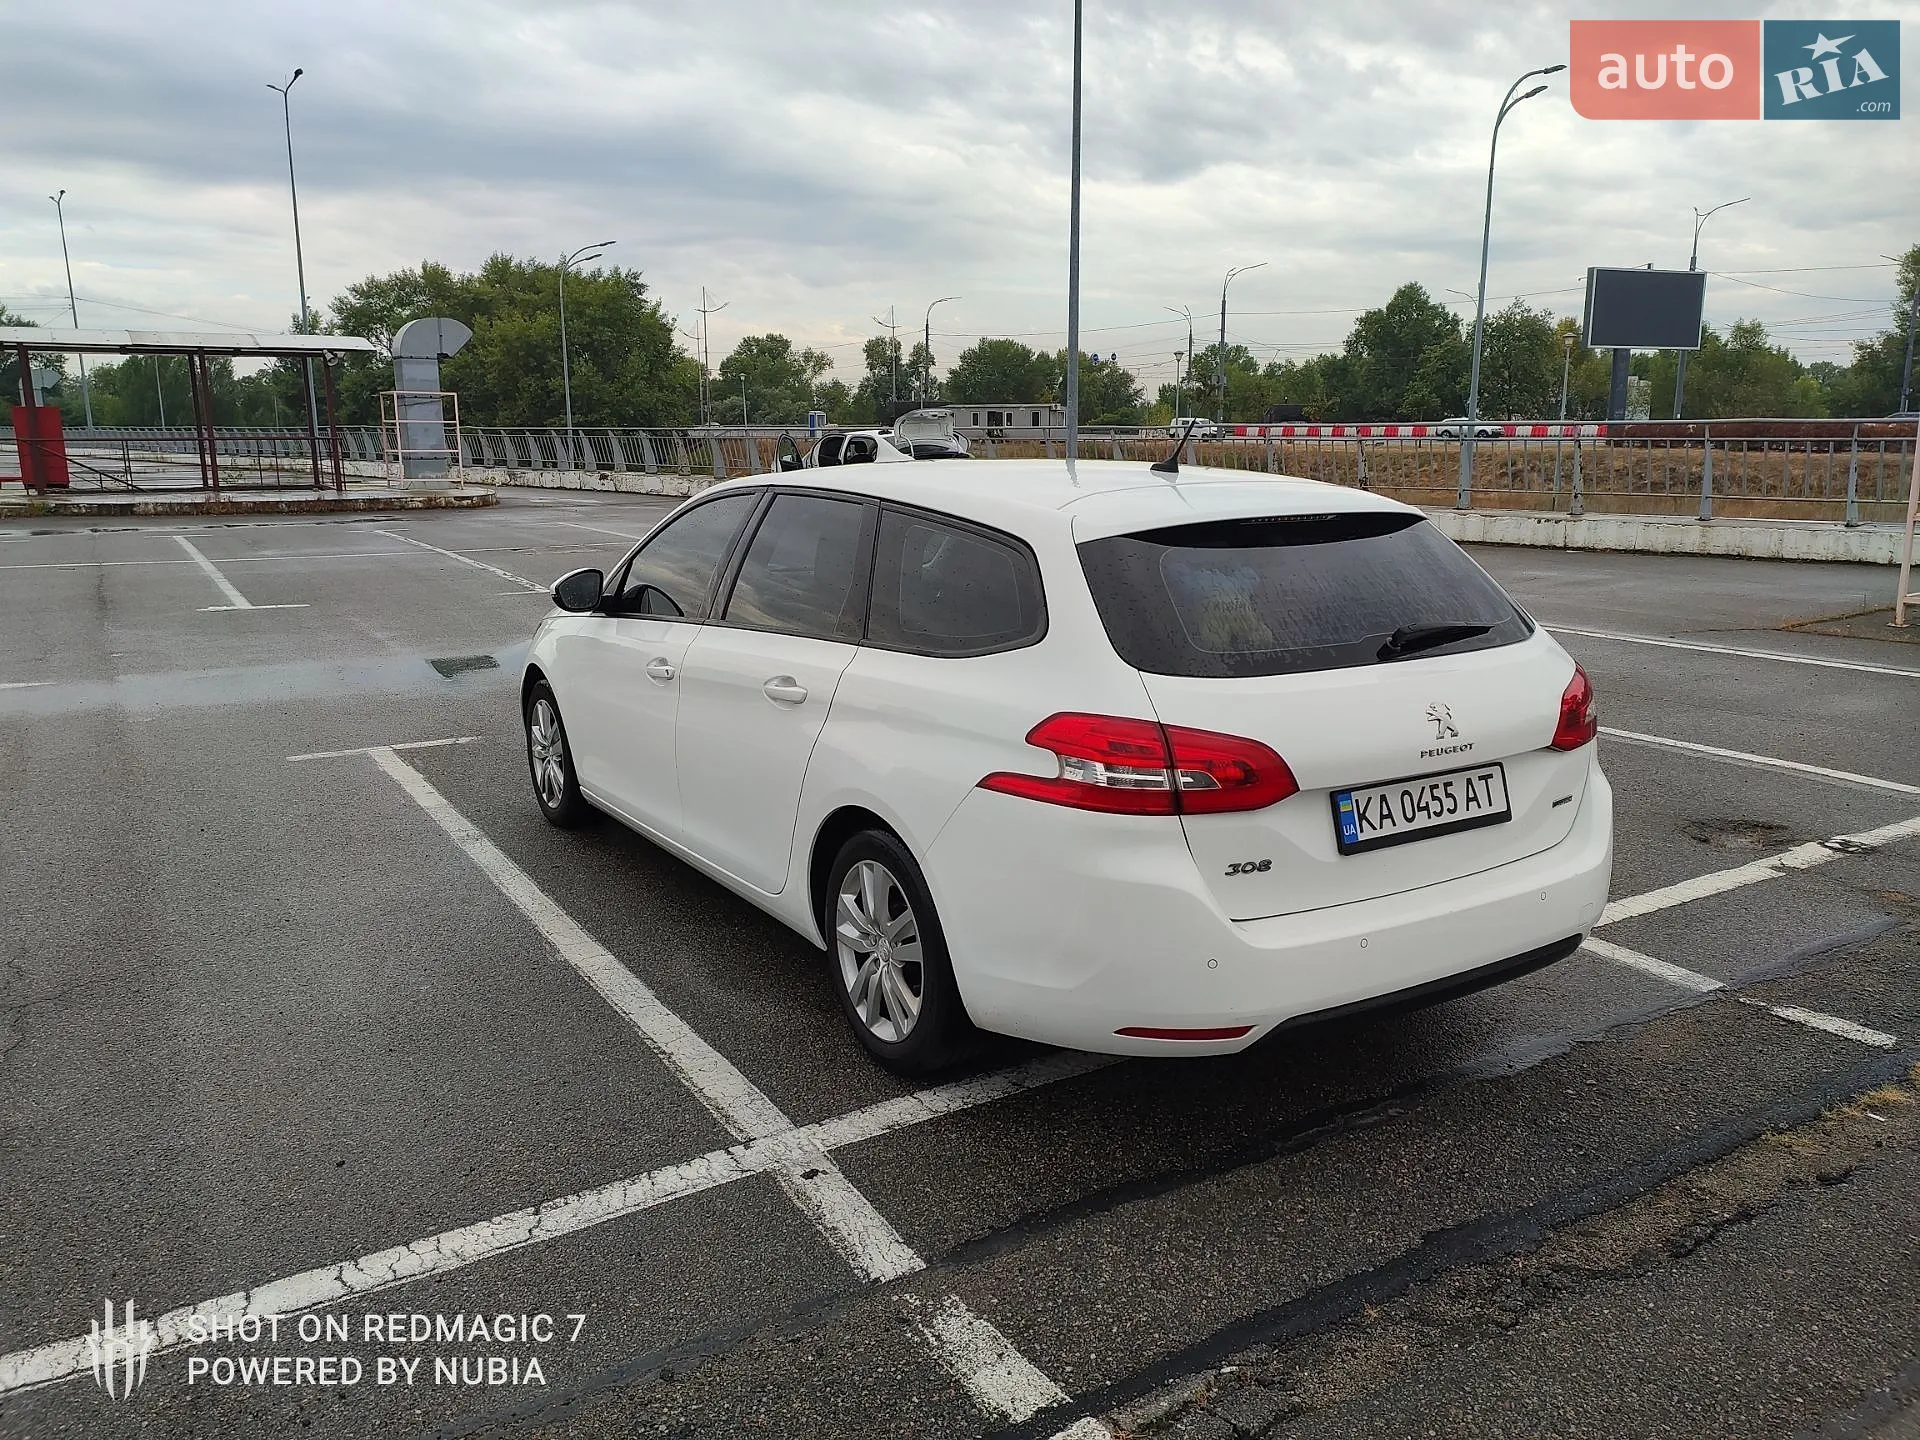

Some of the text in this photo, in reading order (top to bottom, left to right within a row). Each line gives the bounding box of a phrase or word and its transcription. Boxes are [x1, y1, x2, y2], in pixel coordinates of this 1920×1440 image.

[1419, 742, 1475, 759] PEUGEOT
[1354, 773, 1494, 834] KA 0455 AT
[1343, 823, 1357, 836] UA
[1224, 858, 1273, 877] 308
